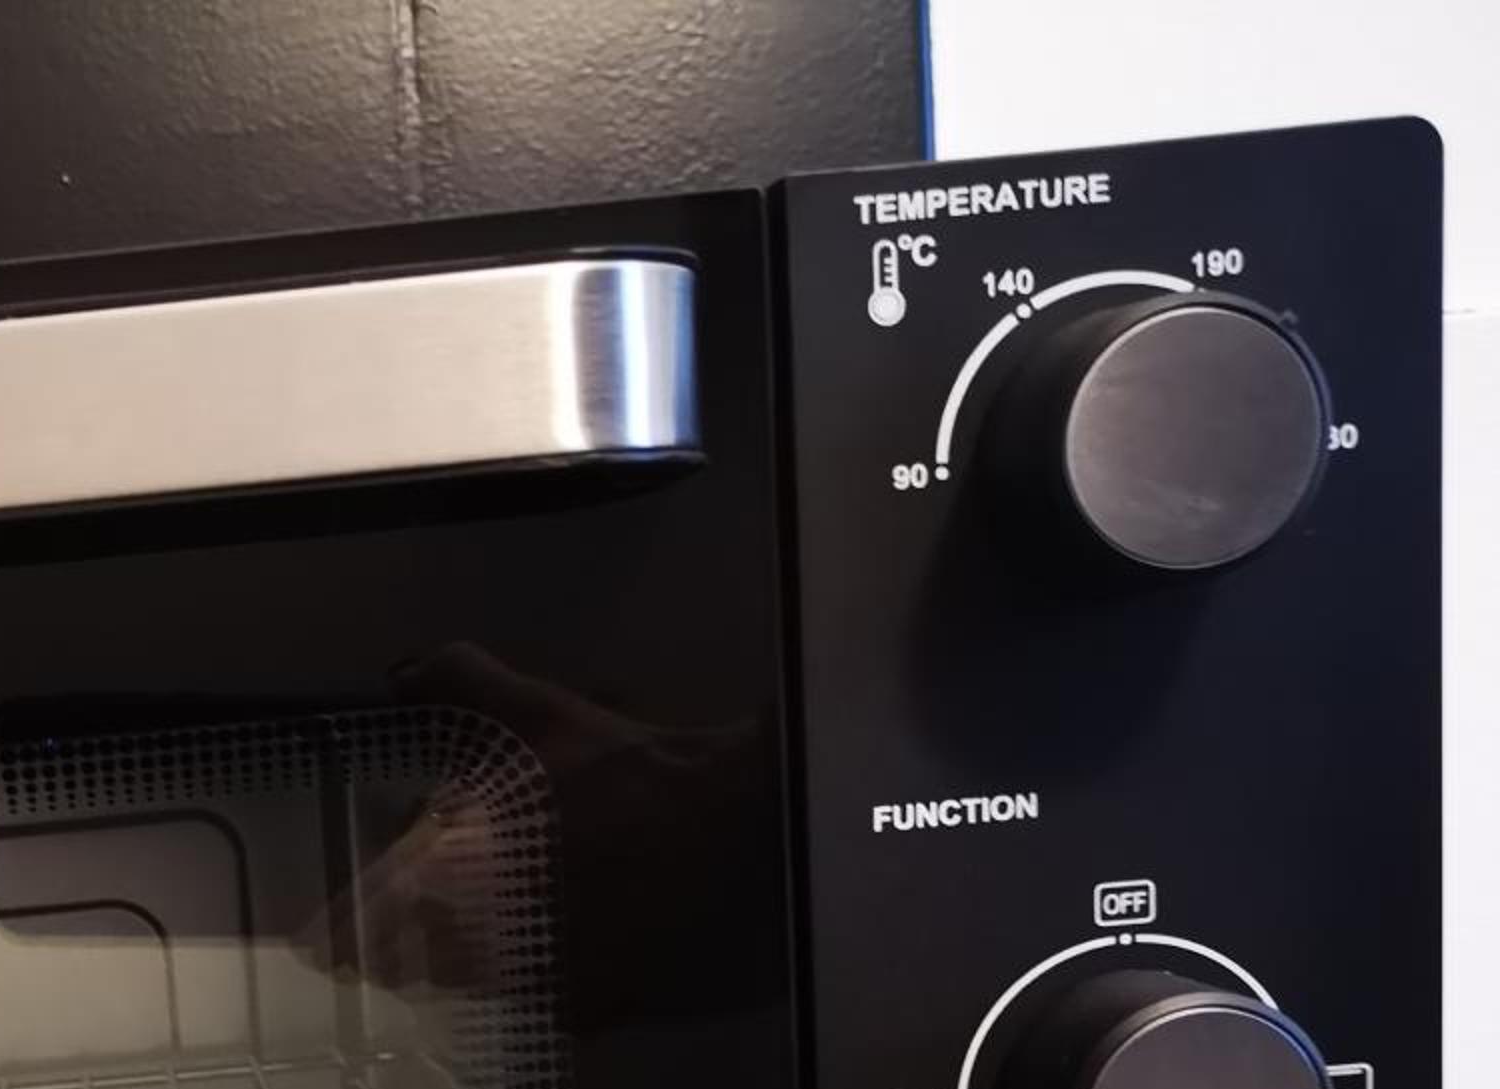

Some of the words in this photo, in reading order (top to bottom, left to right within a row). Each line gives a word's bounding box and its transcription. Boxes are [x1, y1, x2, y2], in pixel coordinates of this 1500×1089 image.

[853, 173, 1111, 224] TEMPERATURE
[1191, 249, 1243, 279] 190
[982, 266, 1035, 298] 140
[1328, 422, 1359, 450] 30
[892, 463, 928, 490] 90
[873, 792, 1039, 833] FUNCTION
[1102, 890, 1148, 916] OFF
